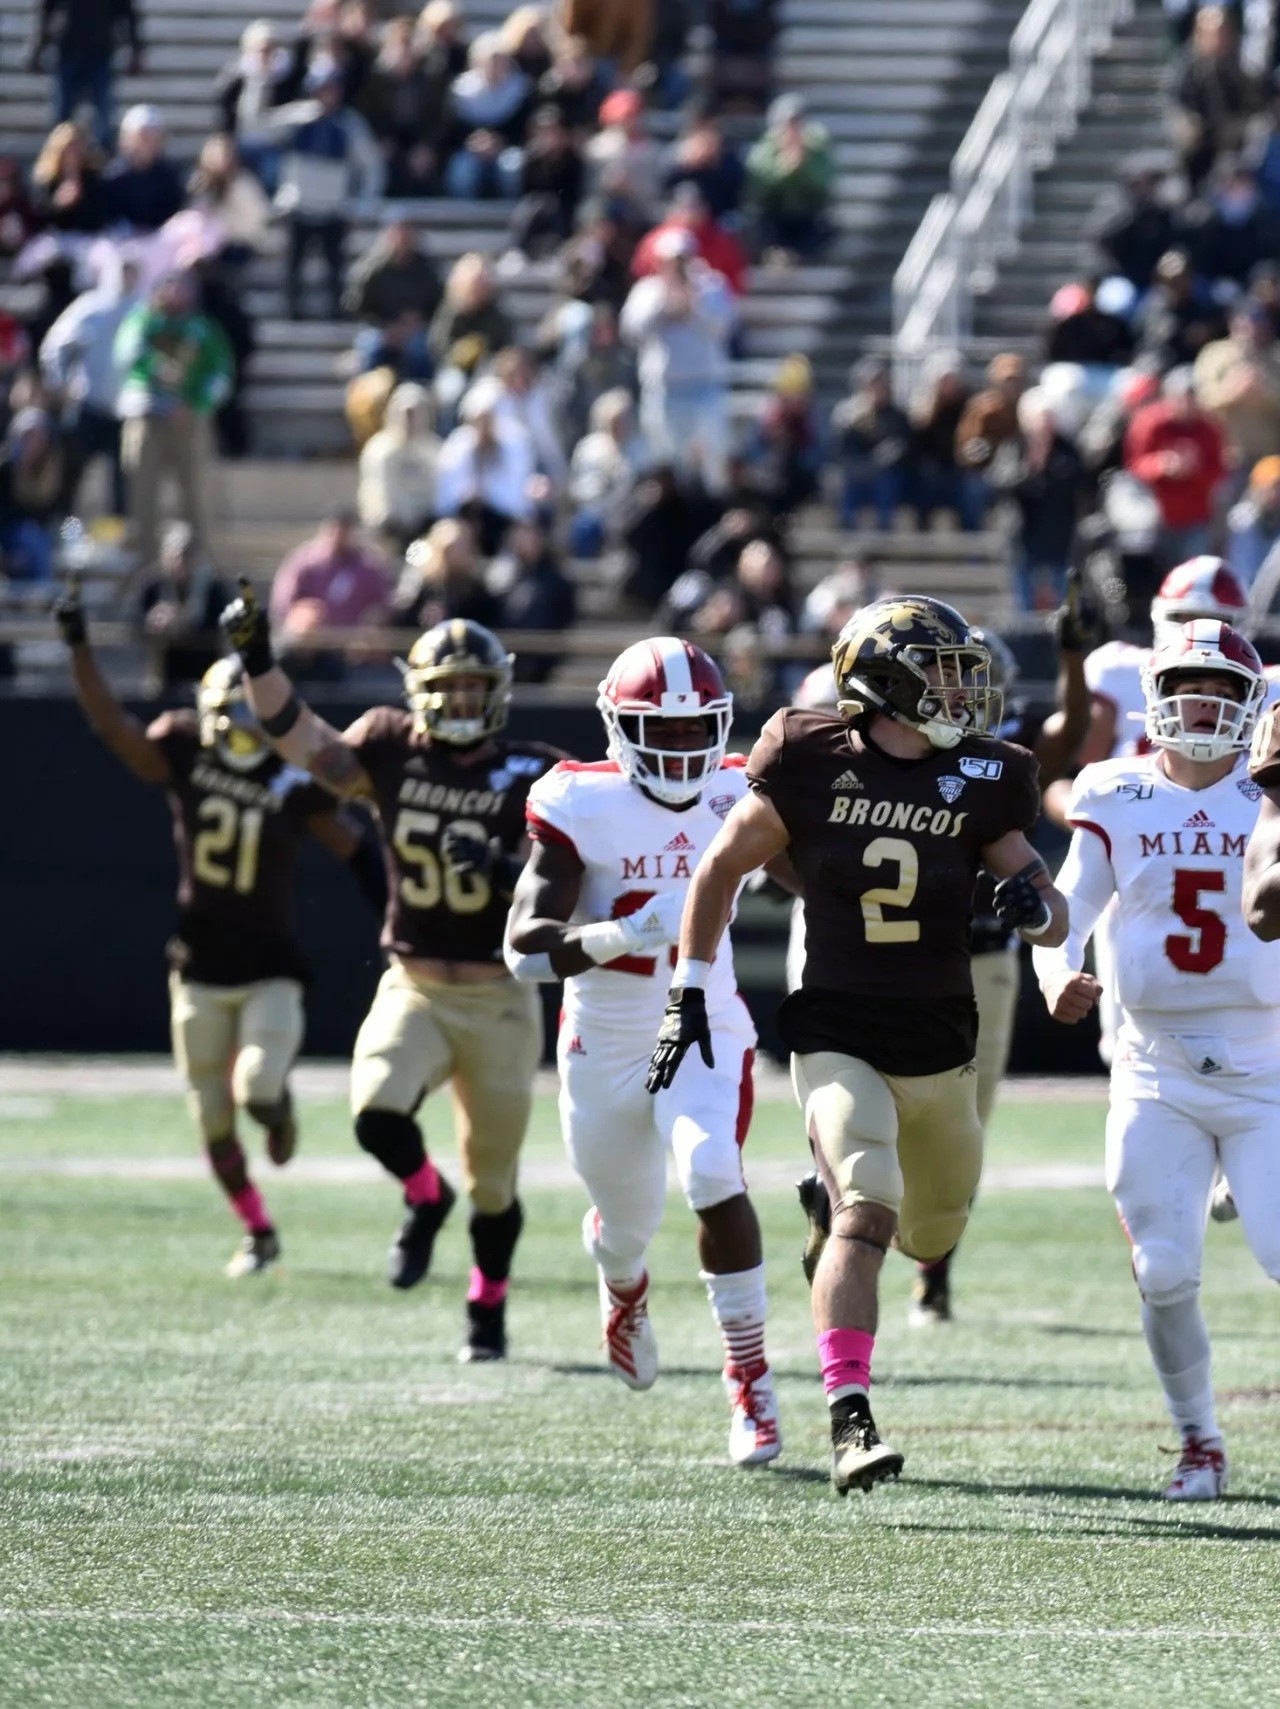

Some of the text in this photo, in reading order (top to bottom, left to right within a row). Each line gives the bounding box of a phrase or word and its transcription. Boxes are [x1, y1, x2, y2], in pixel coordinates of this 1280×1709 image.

[962, 758, 1002, 778] 150
[831, 780, 864, 790] adidas
[827, 796, 969, 838] BRONCOS
[1183, 820, 1216, 829] adidas
[194, 795, 262, 894] 21
[1138, 831, 1249, 857] MIAM
[621, 855, 691, 880] MIA
[860, 837, 920, 943] 2
[1164, 869, 1228, 975] 5
